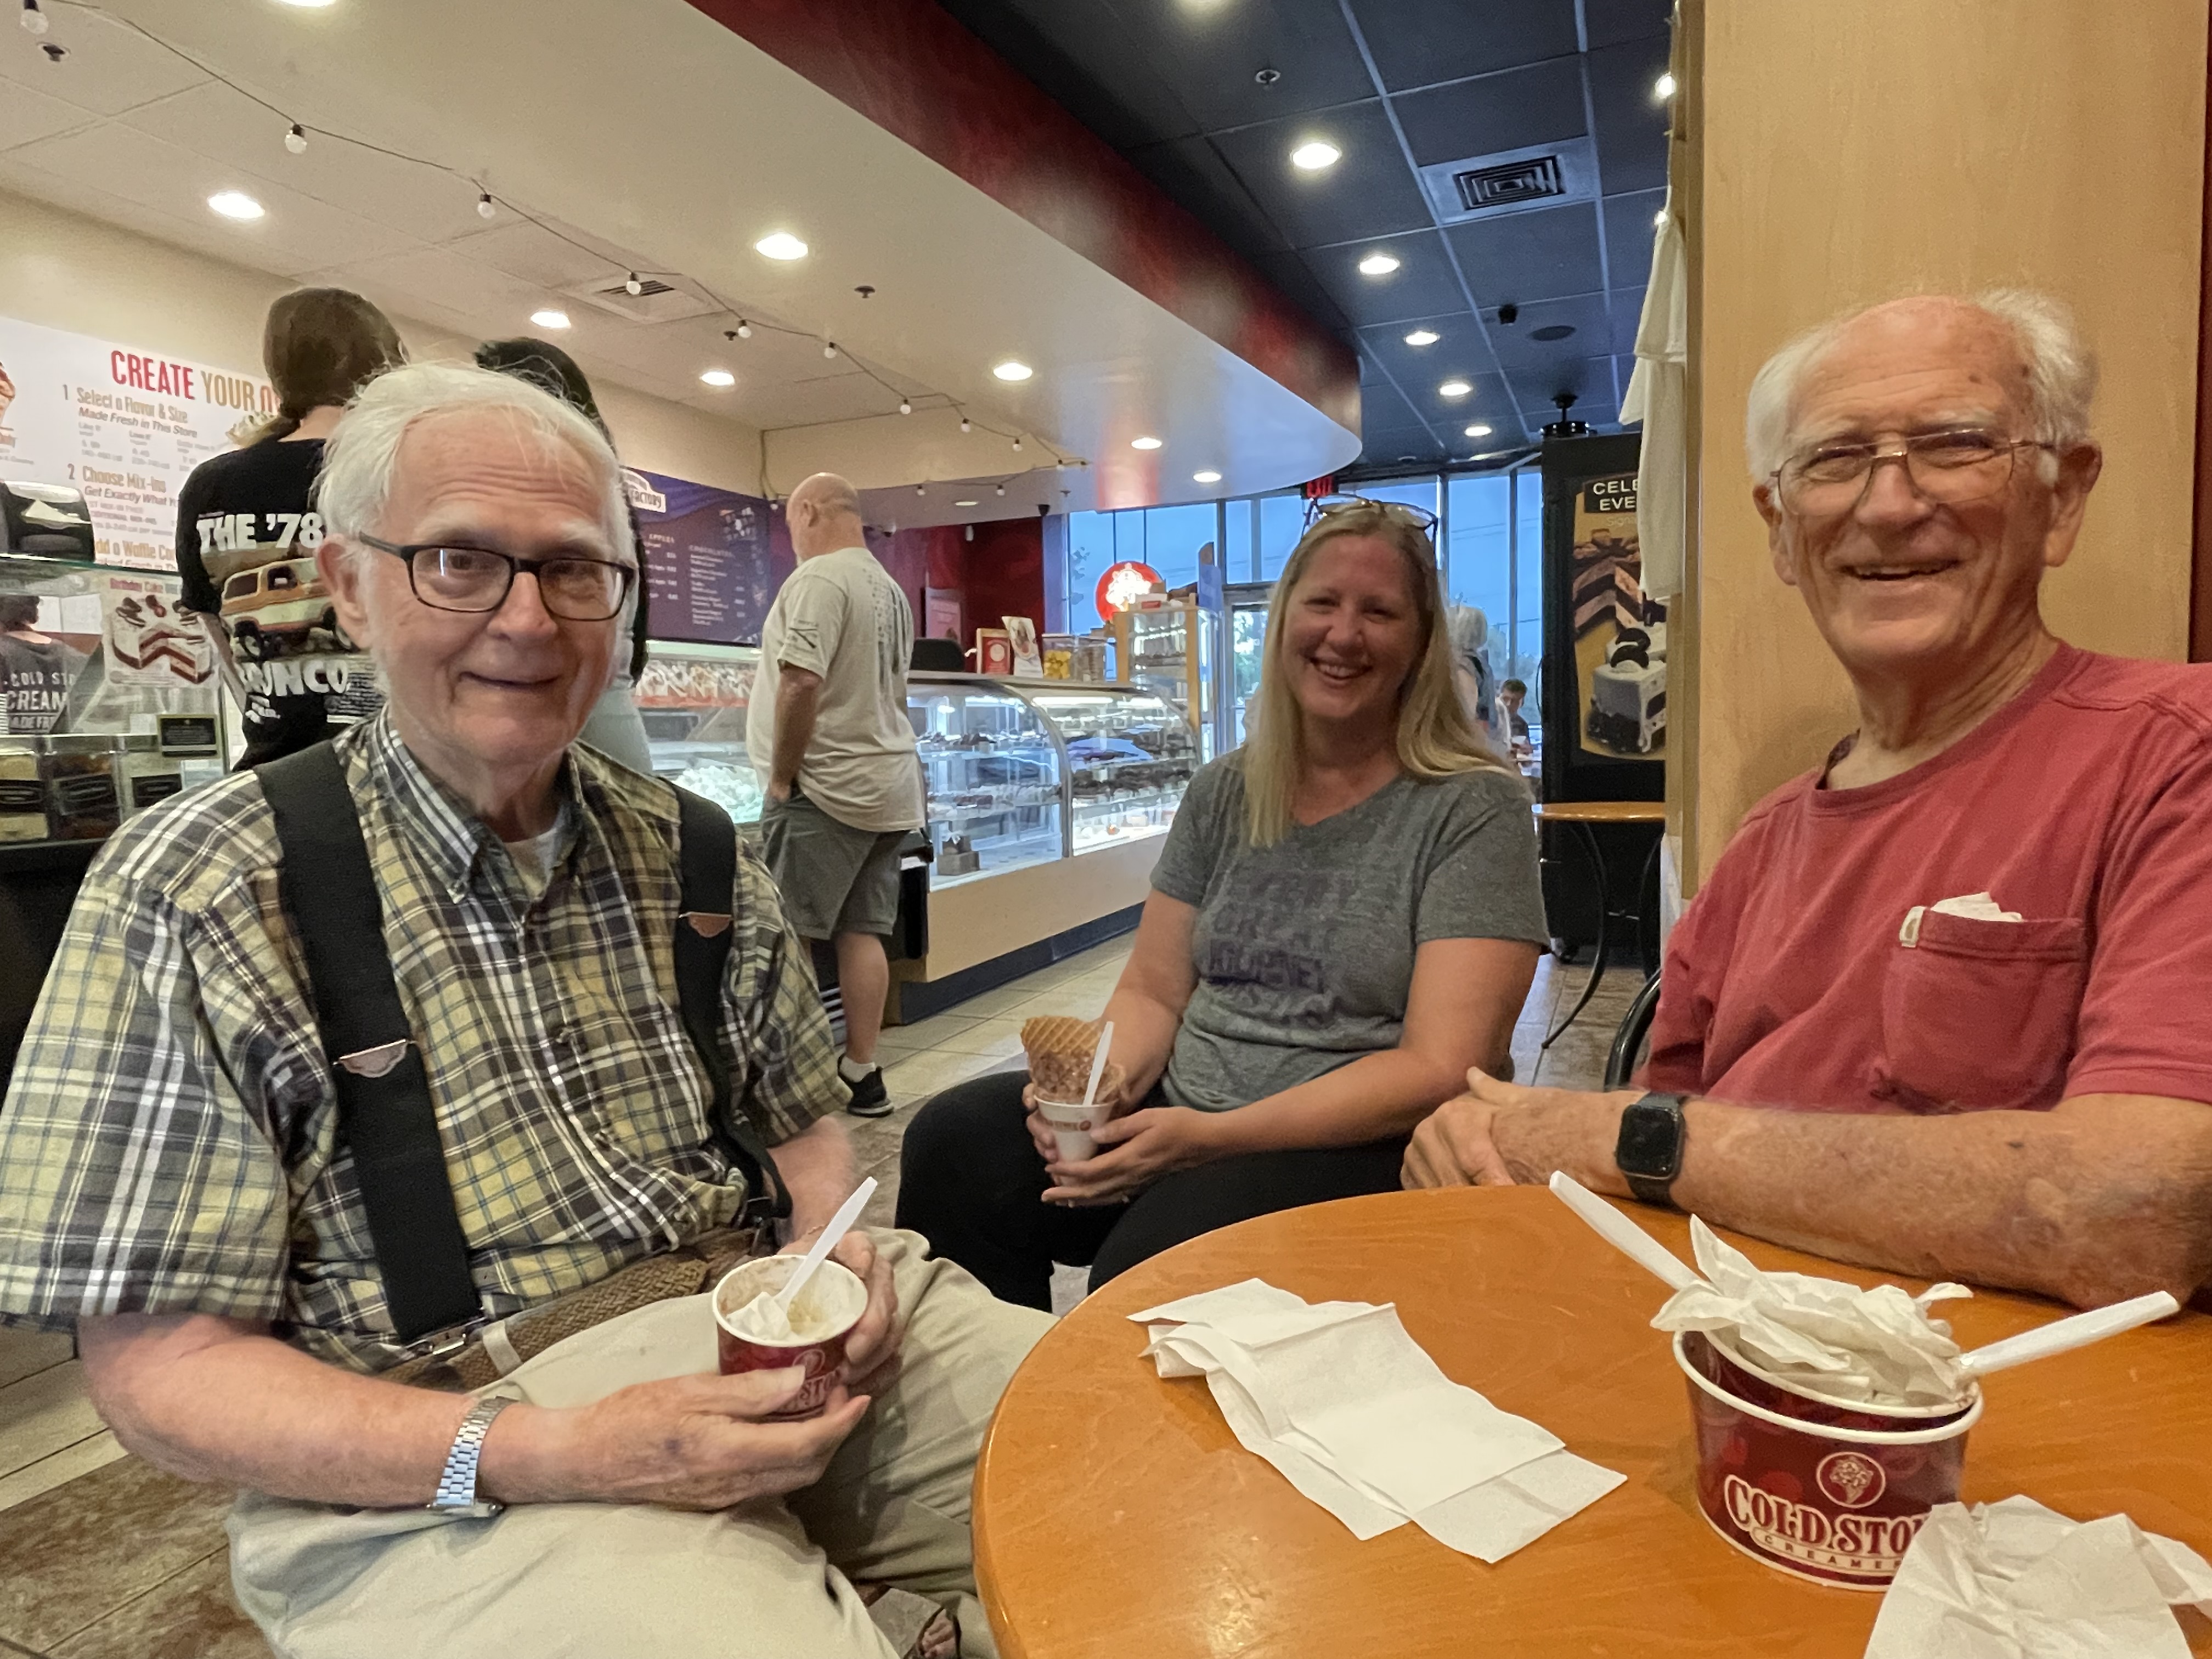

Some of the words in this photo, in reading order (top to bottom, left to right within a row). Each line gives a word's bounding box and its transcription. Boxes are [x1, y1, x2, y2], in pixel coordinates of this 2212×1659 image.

[111, 350, 195, 400] CREATE
[201, 370, 256, 411] YOUR
[261, 385, 281, 413] O
[63, 384, 69, 400] 1
[77, 387, 113, 409] Select
[168, 405, 189, 424] Size
[79, 407, 109, 421] Made
[110, 413, 139, 426] Fresh
[141, 419, 150, 429] in
[153, 420, 172, 433] This
[173, 425, 198, 438] Store
[67, 463, 75, 480] 2
[82, 466, 125, 487] Choose
[85, 486, 102, 497] Get
[104, 488, 141, 504] Exactly
[143, 494, 167, 506] What
[1600, 496, 1636, 511] EVE
[196, 512, 257, 554] THE
[266, 512, 324, 549] '78
[95, 538, 110, 555] dd
[122, 540, 156, 559] Waffle
[10, 670, 44, 687] COLD
[1726, 1478, 1827, 1545] COLD
